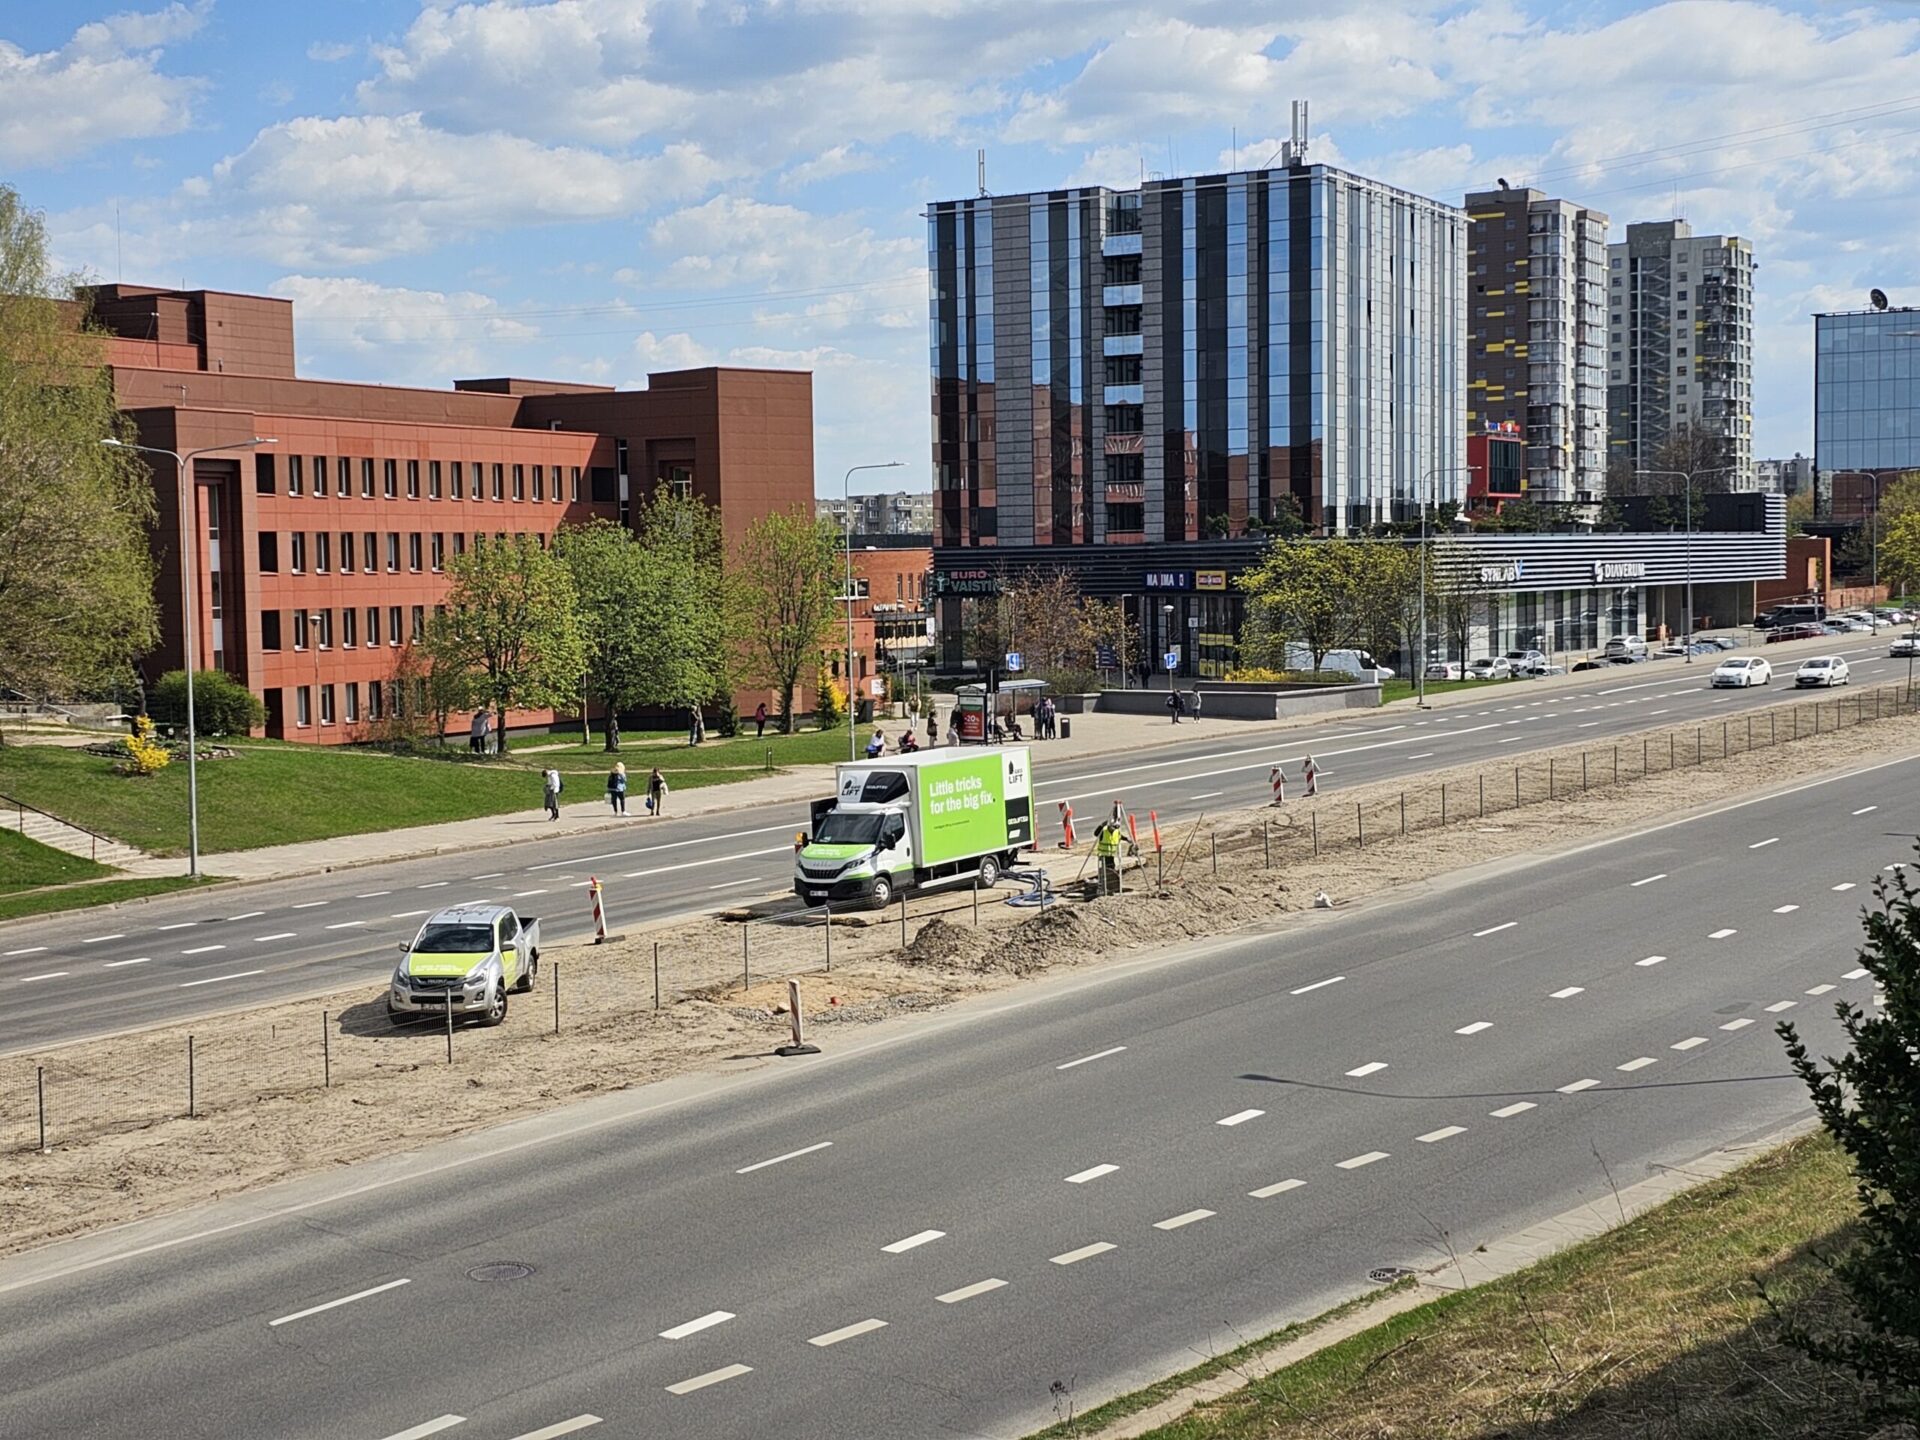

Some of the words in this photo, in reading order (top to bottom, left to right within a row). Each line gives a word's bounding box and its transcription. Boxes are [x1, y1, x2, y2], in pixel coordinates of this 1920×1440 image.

[951, 571, 987, 579] EURO
[1480, 567, 1515, 582] SYNLAB
[1605, 563, 1645, 578] DIAVERUM
[951, 580, 1005, 592] VAISTIN
[930, 780, 954, 797] Little
[955, 776, 982, 792] tricks
[1008, 774, 1023, 784] LIFT
[930, 800, 944, 815] for
[946, 797, 961, 811] the
[963, 793, 979, 810] big
[980, 790, 996, 806] fix.
